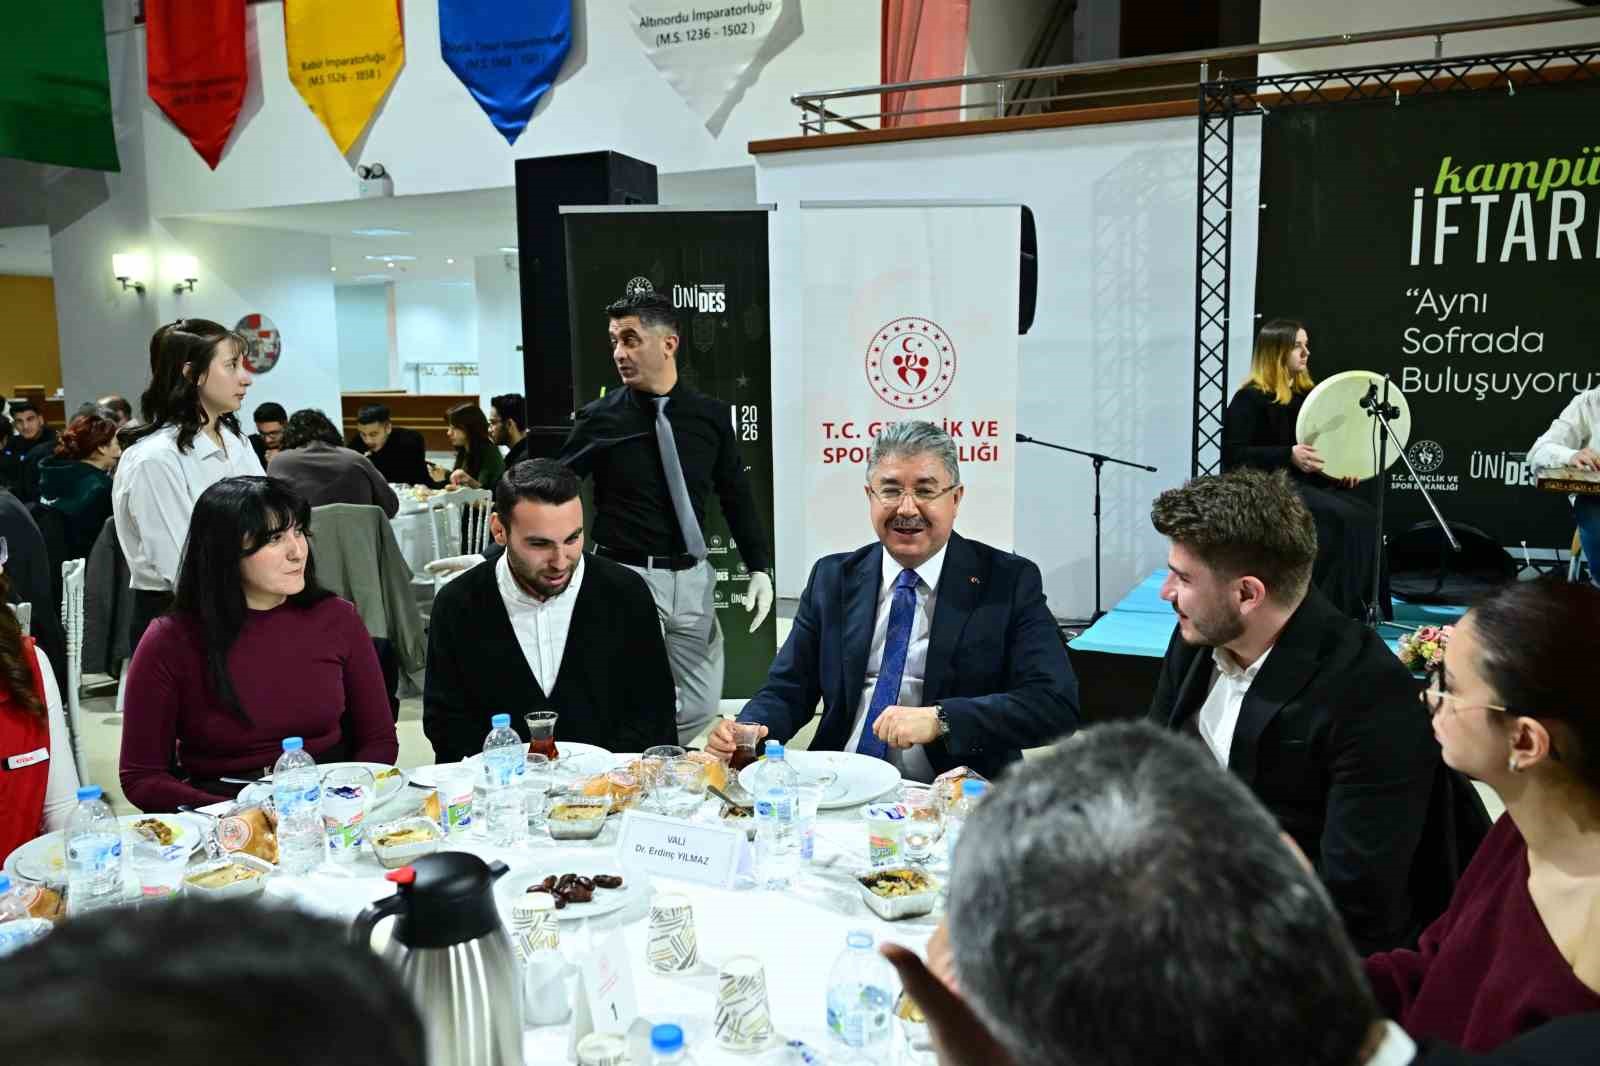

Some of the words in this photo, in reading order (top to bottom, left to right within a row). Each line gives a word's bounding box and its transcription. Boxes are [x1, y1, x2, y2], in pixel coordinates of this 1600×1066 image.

[639, 11, 689, 28] Altınordu
[686, 27, 711, 41] 1236
[1410, 188, 1600, 266] İFTAR
[1402, 326, 1545, 355] Sofrada
[741, 405, 758, 423] 20
[741, 424, 758, 441] 26
[822, 422, 860, 439] T.C.
[971, 421, 998, 437] VE
[1447, 475, 1459, 483] VE
